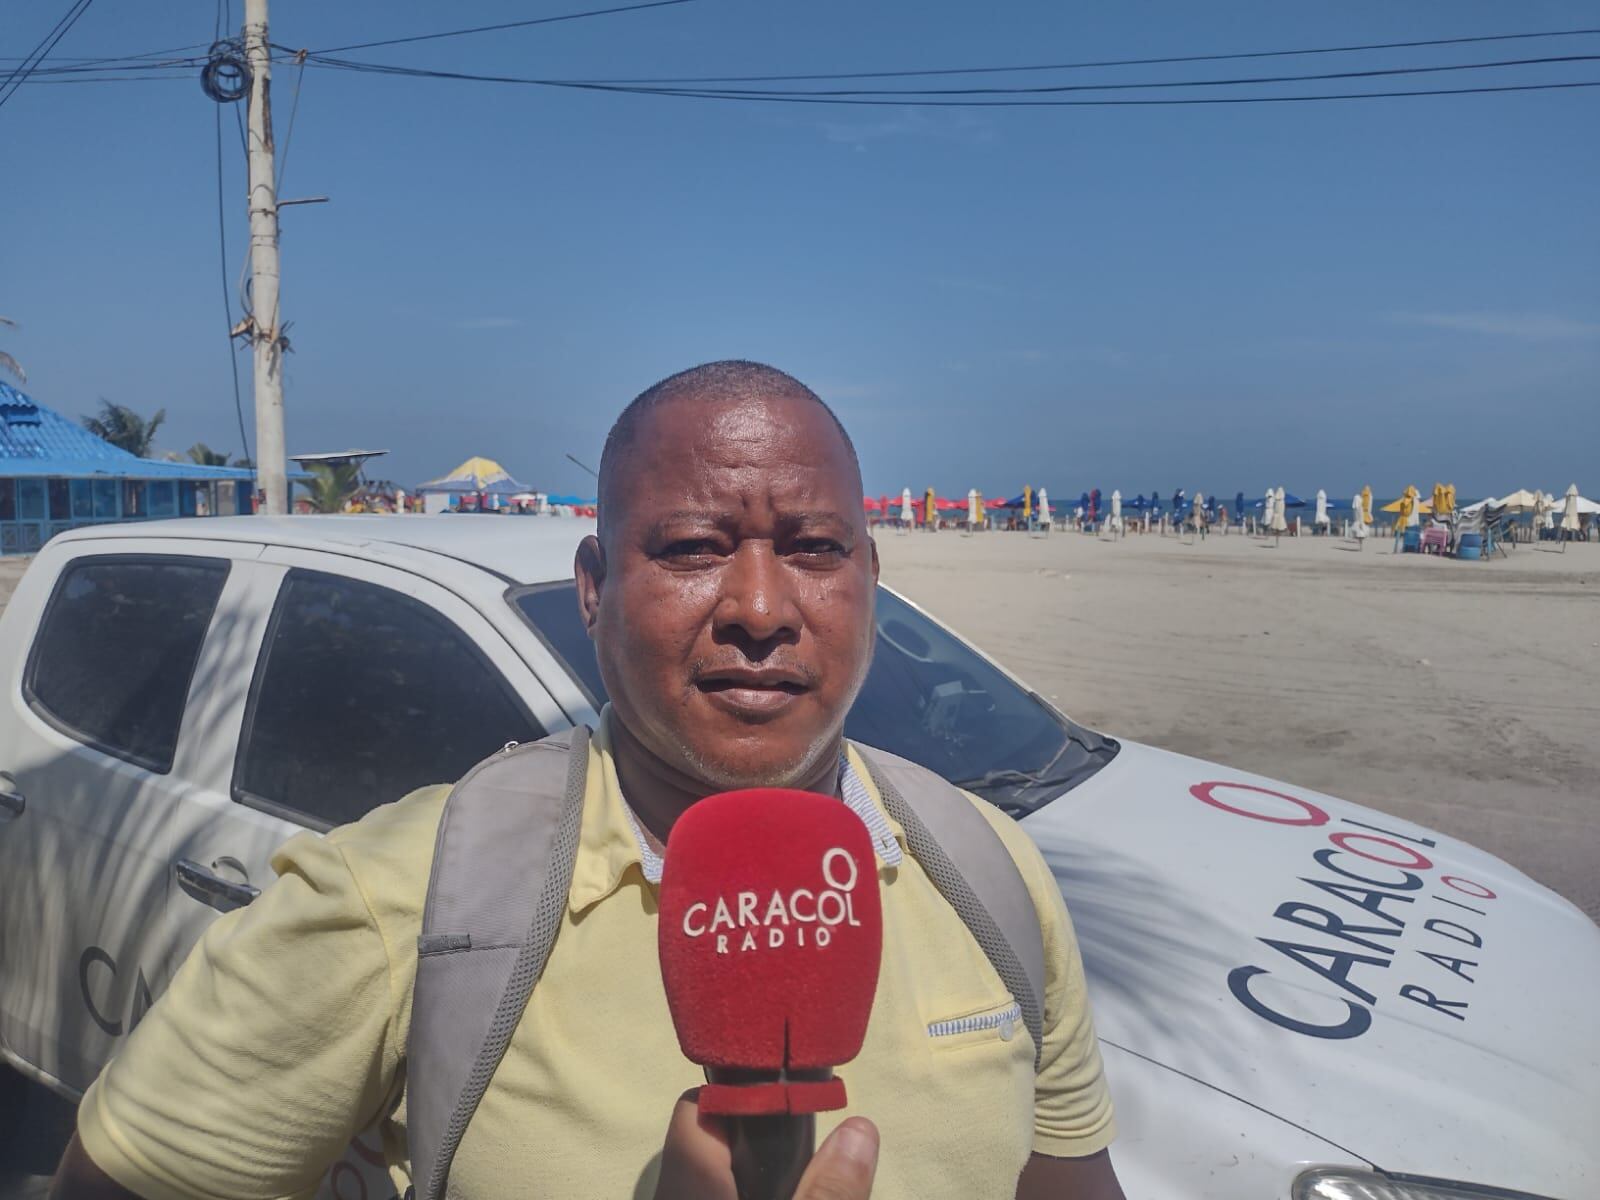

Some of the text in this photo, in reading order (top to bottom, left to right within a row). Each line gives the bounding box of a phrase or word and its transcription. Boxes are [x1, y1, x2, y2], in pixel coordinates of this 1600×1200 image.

[683, 888, 861, 937] CARACOL
[716, 926, 831, 954] RADIO
[1227, 818, 1436, 1040] CARACOL
[1399, 876, 1497, 1021] RADIO
